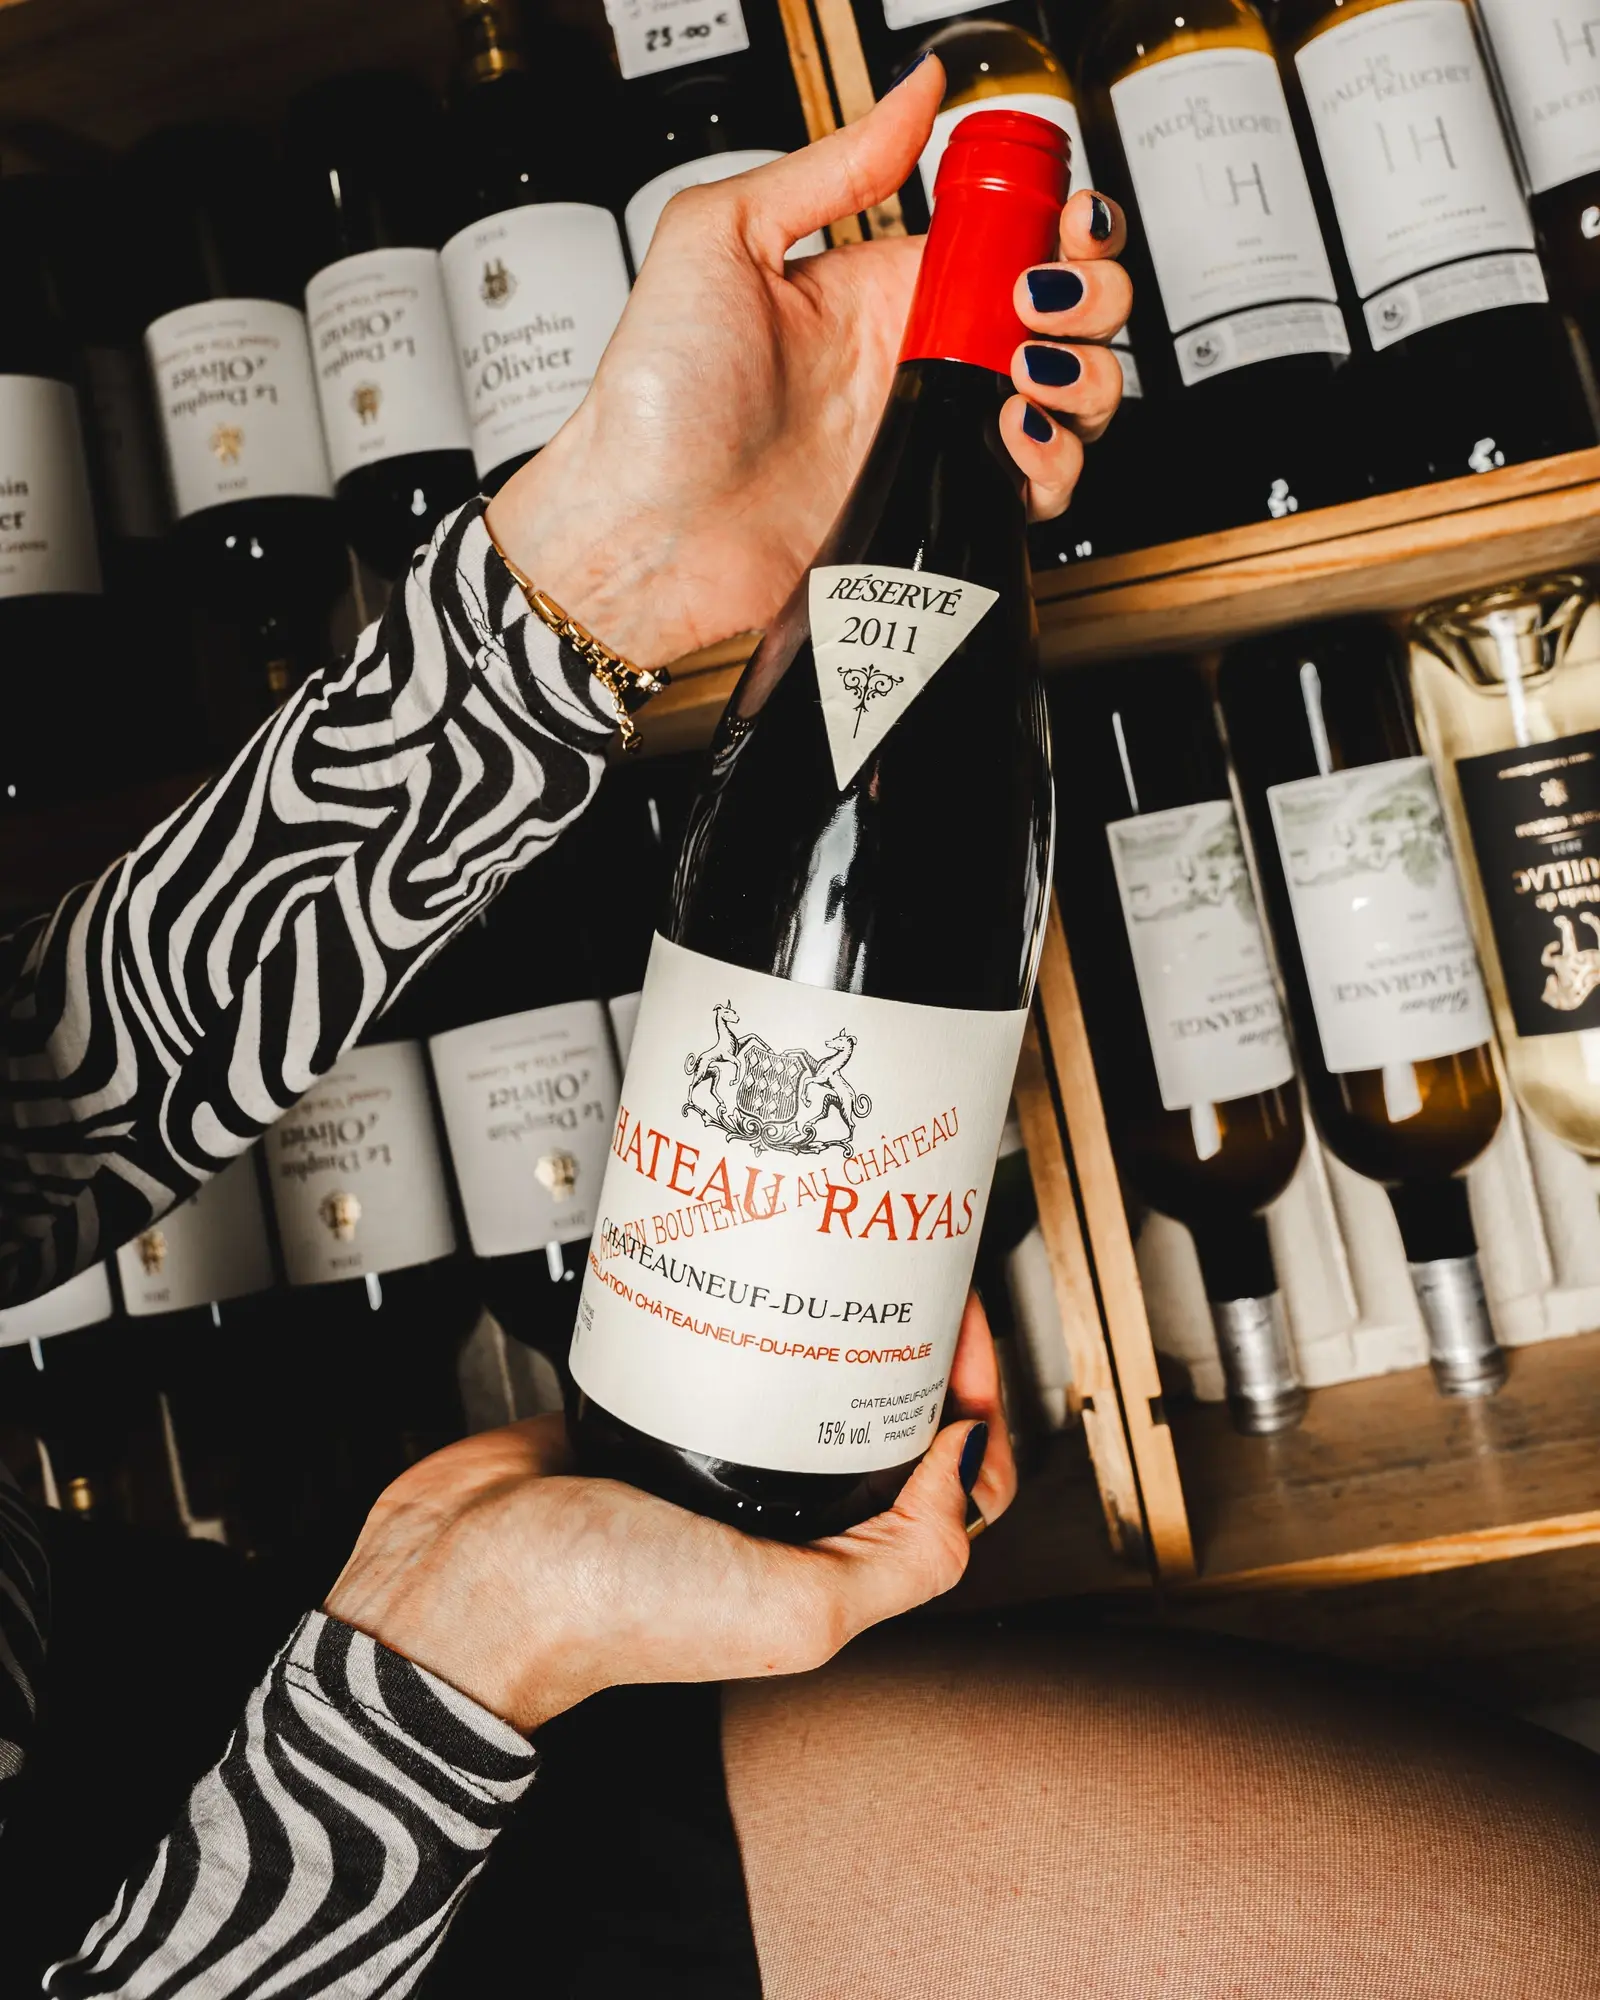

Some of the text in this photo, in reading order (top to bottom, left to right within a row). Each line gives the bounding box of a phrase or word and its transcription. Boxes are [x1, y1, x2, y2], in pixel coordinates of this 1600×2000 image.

[481, 314, 576, 354] Dauphin
[827, 574, 962, 616] RÉSERVÉ
[838, 616, 918, 654] 2011
[1512, 857, 1600, 894] UILLAC
[613, 1105, 977, 1241] HATEAU RAYAS
[624, 1218, 646, 1253] EN
[652, 1183, 787, 1245] BOUTEILLE
[797, 1168, 831, 1207] AU
[843, 1107, 960, 1186] CHÂTEAU
[602, 1217, 913, 1324] CHATEAUNEUF-DU-PAPE
[635, 1293, 839, 1362] CHÂTEAUNEUF-DU-PAPE
[845, 1342, 933, 1364] CONTRÔLÉE
[850, 1378, 945, 1409] CHATEAUNEUF-DU-PAPE
[817, 1420, 871, 1445] 15% vol.
[883, 1406, 924, 1424] VAUCLUSE
[884, 1425, 917, 1442] FRANCE
